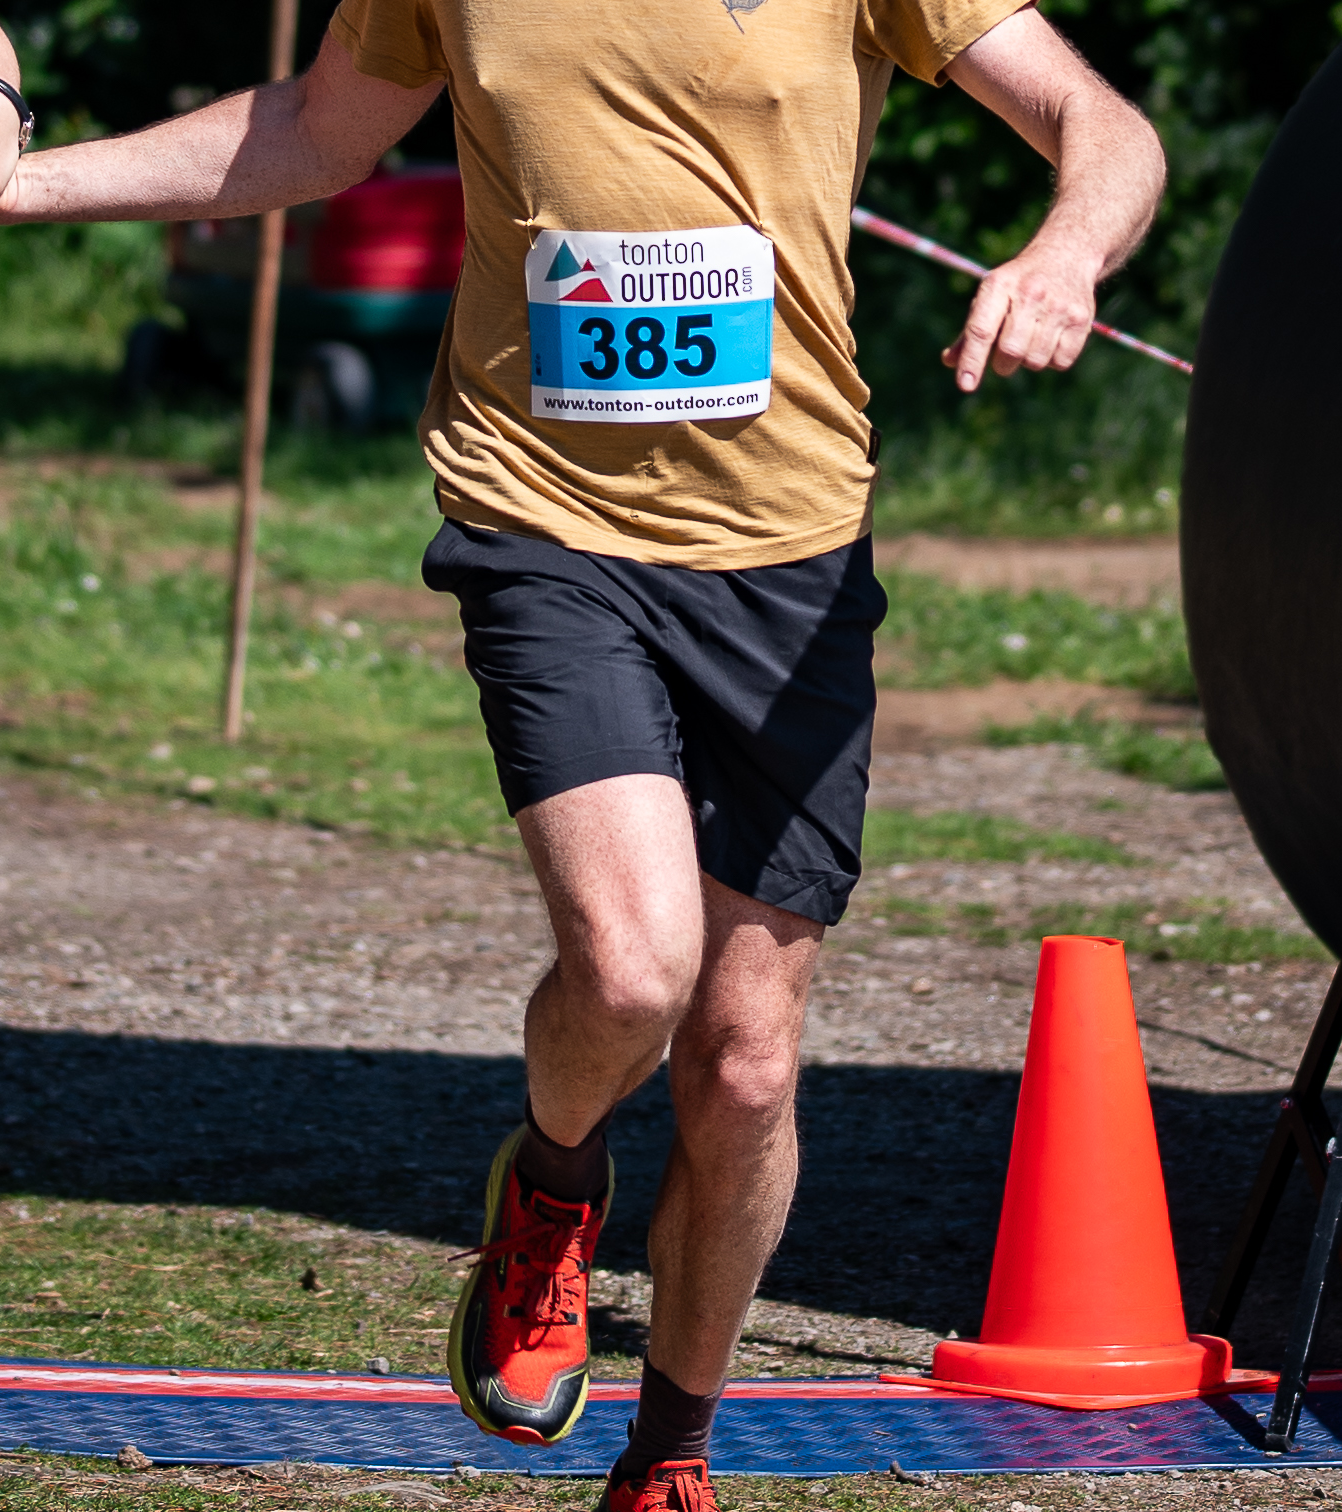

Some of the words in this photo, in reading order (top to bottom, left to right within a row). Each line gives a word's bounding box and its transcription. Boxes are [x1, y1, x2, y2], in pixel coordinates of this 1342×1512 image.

[618, 238, 704, 266] tonton
[621, 267, 740, 303] OUTDOOR
[578, 313, 717, 381] 385
[543, 391, 759, 412] www.tonton-outdoor.com
